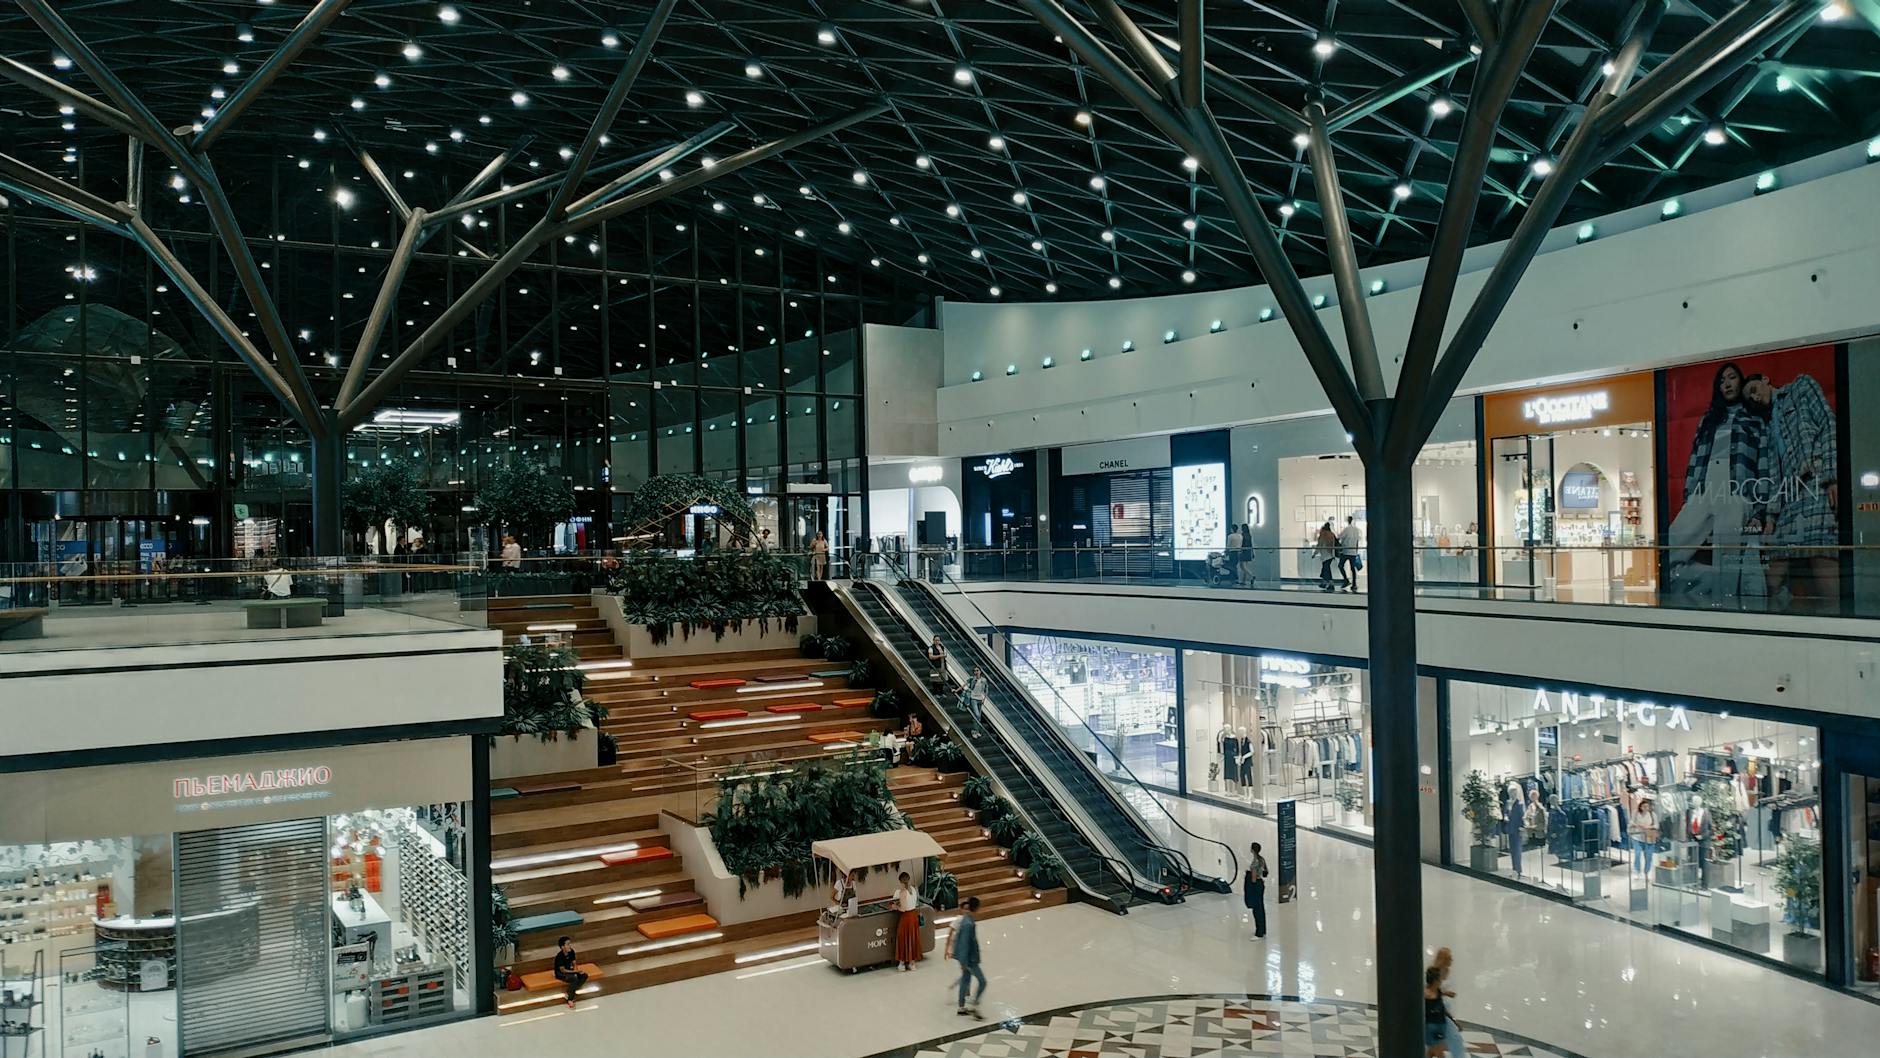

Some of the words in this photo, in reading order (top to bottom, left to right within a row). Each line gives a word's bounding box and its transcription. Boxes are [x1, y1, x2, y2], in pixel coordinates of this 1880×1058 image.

[983, 457, 1014, 476] Kiehl's
[1099, 459, 1129, 470] CHANEL
[1533, 689, 1690, 731] ANTIGA
[174, 765, 333, 798] ПЬЕМАДЖИО
